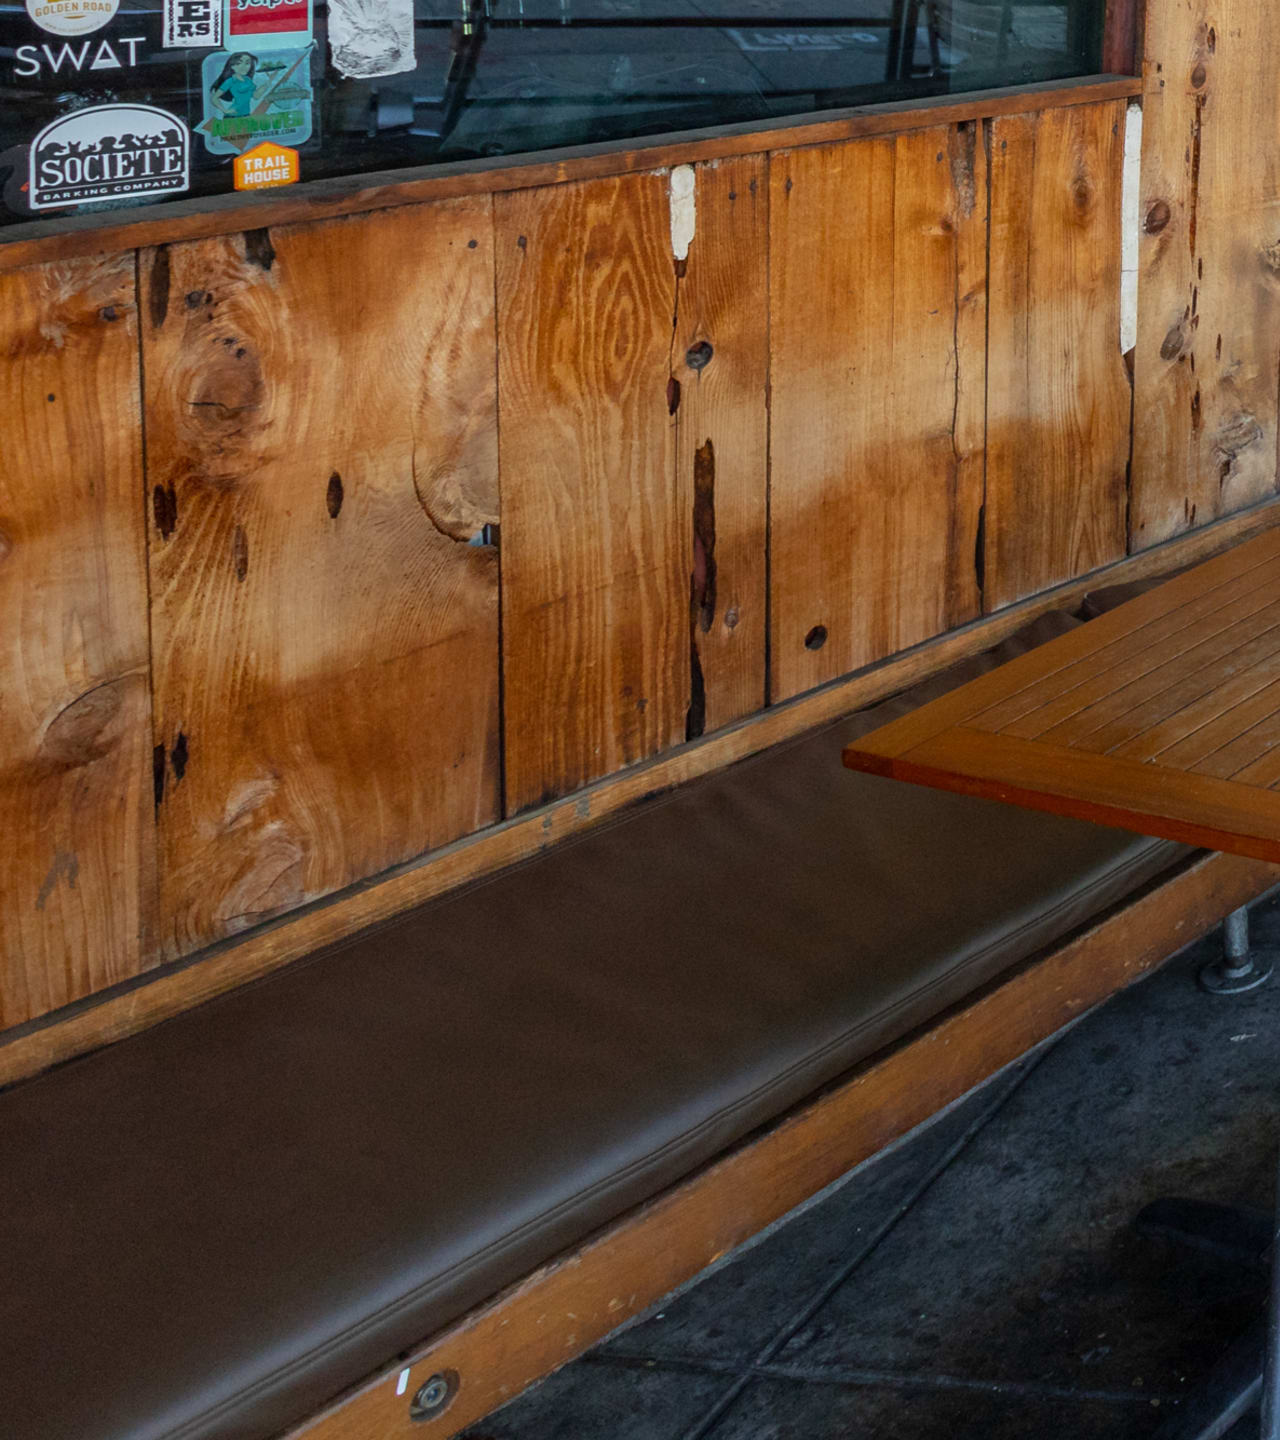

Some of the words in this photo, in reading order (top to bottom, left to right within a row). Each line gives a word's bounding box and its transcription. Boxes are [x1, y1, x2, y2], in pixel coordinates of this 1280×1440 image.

[35, 1, 79, 17] GOLDEN
[82, 2, 112, 13] ROAD
[14, 37, 147, 76] SWAT
[39, 147, 183, 188] SOCIETE
[243, 155, 289, 171] TRAIL
[243, 168, 290, 184] HOUSE
[42, 187, 108, 201] BARKING
[114, 179, 179, 193] COMPANY
